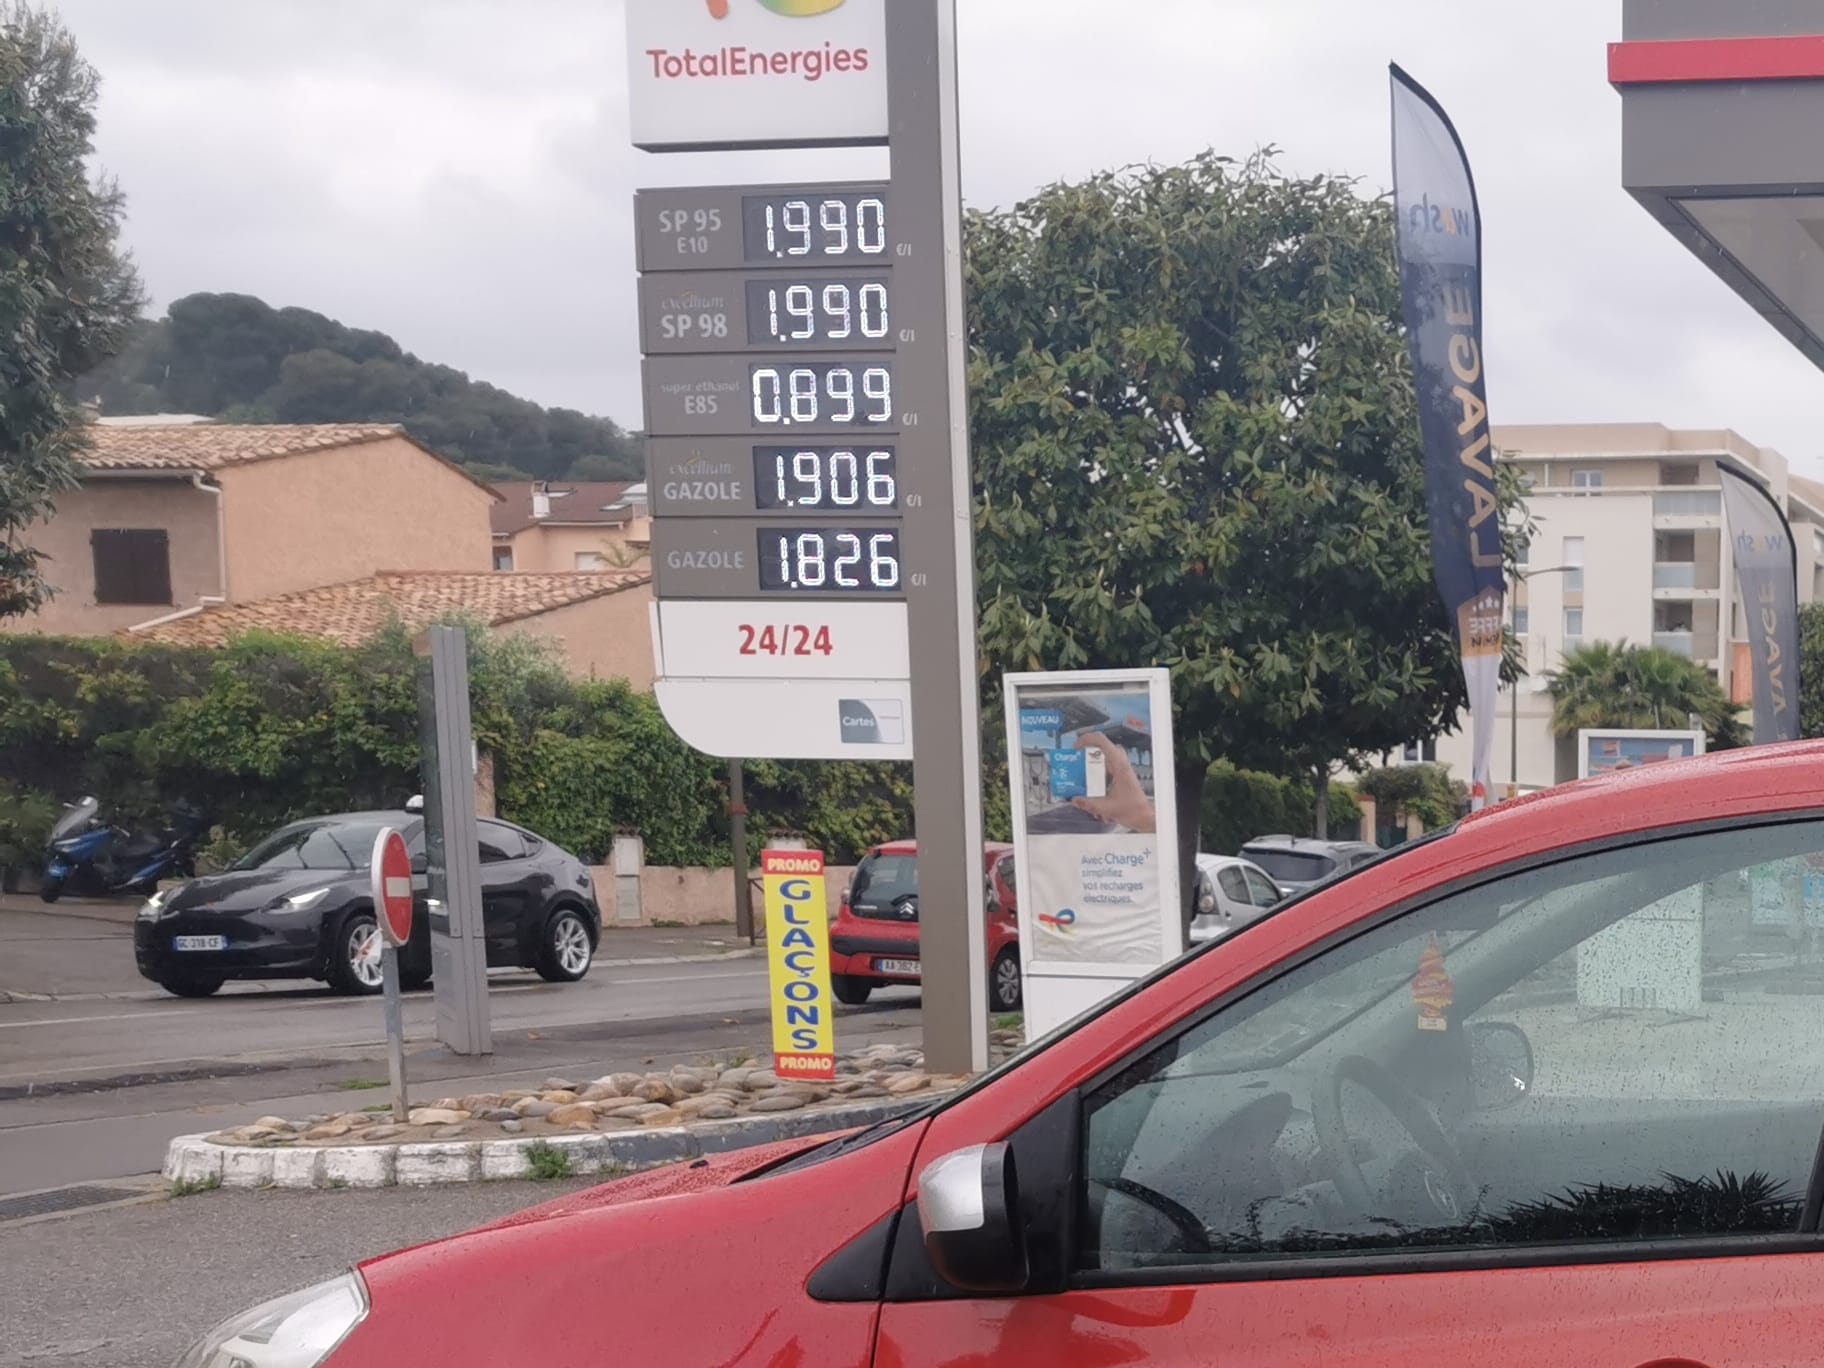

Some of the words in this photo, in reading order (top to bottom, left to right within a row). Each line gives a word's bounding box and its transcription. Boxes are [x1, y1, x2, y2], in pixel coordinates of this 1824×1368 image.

[646, 41, 868, 81] TotalEnergies
[659, 210, 687, 232] SP
[694, 208, 721, 231] 95
[765, 198, 884, 258] 1.990
[677, 236, 708, 253] E10
[769, 284, 887, 341] 1.990
[661, 314, 692, 338] SP
[699, 313, 727, 338] 98
[685, 395, 718, 414] E85
[753, 368, 891, 424] 0.899
[664, 481, 740, 501] GAZOLE
[776, 452, 896, 507] 1.906
[667, 550, 744, 569] GAZOLE
[780, 534, 898, 588] 1.826
[738, 624, 833, 656] 24/24
[843, 716, 875, 726] Cartes
[767, 858, 820, 872] PROMO
[1081, 855, 1103, 865] Avec
[779, 879, 819, 1050] GLAÇONS
[780, 1057, 832, 1070] PROMO
